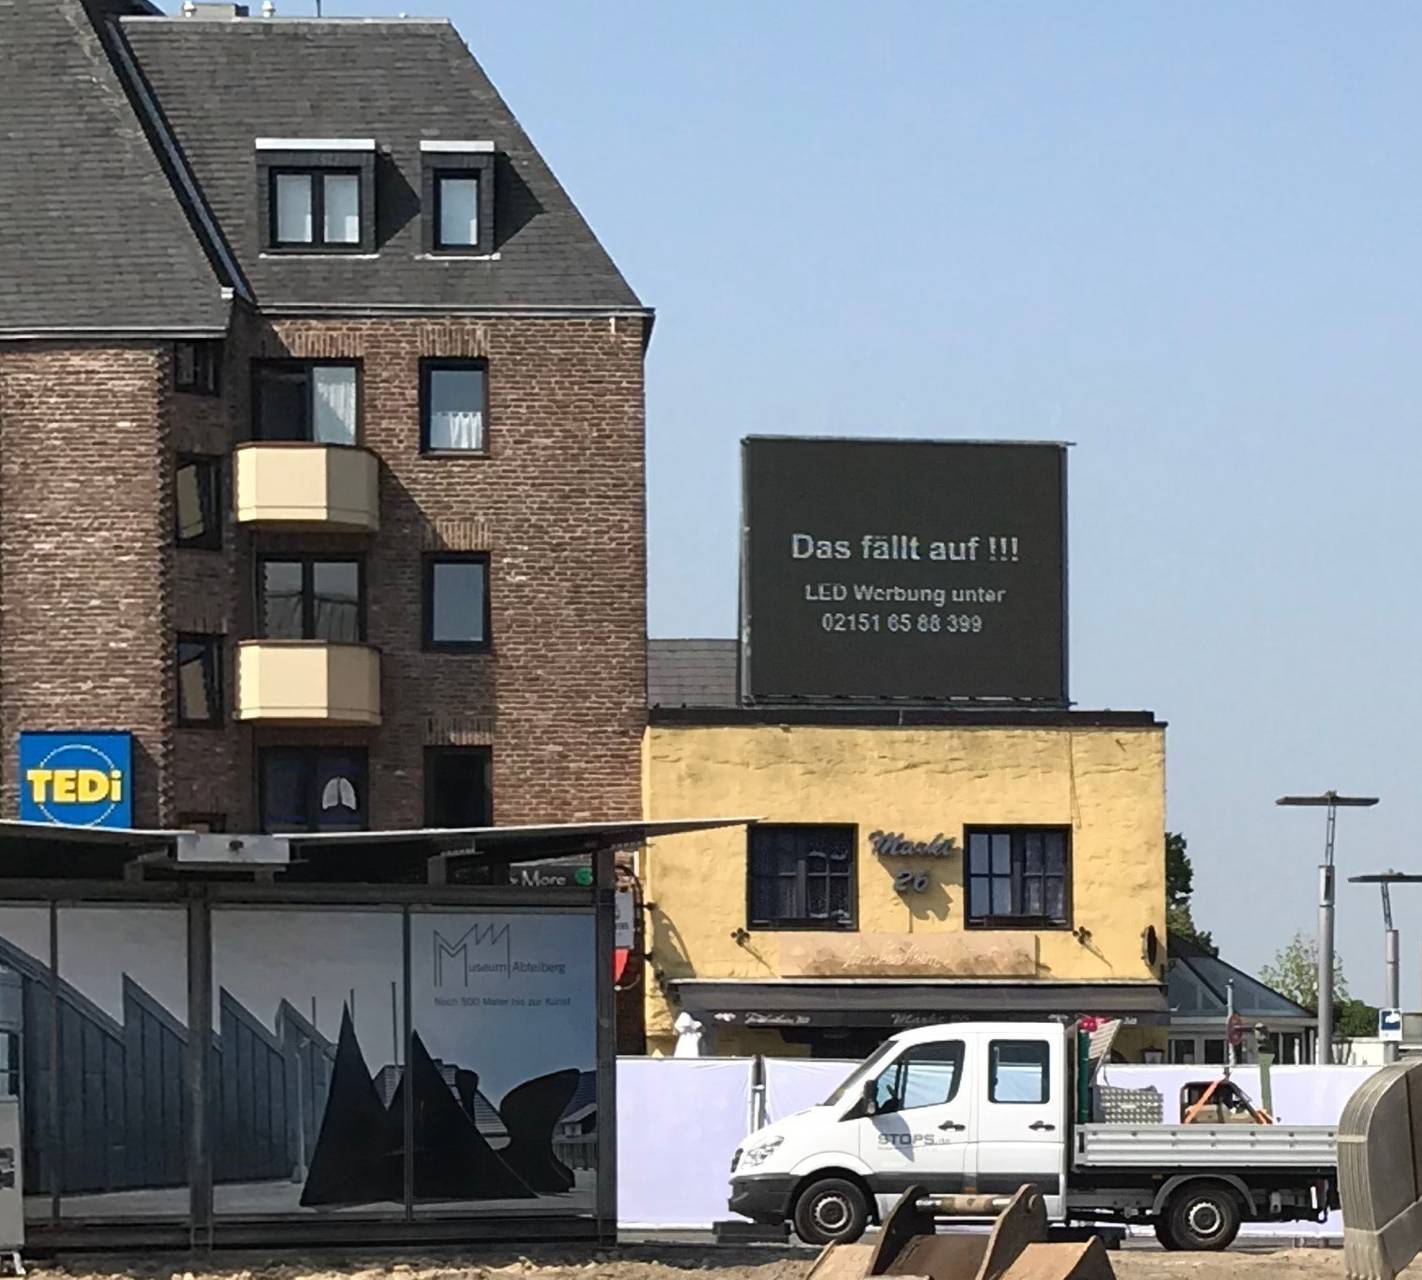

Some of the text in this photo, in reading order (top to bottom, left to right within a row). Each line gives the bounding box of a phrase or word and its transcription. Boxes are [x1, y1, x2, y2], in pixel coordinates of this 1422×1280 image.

[791, 533, 1020, 563] Das fällt auf !!!
[804, 583, 1007, 607] LED Werbung unter
[821, 612, 881, 632] 02151
[946, 614, 983, 634] 399
[26, 768, 122, 803] TEDi
[521, 869, 567, 888] More
[894, 869, 929, 893] 26
